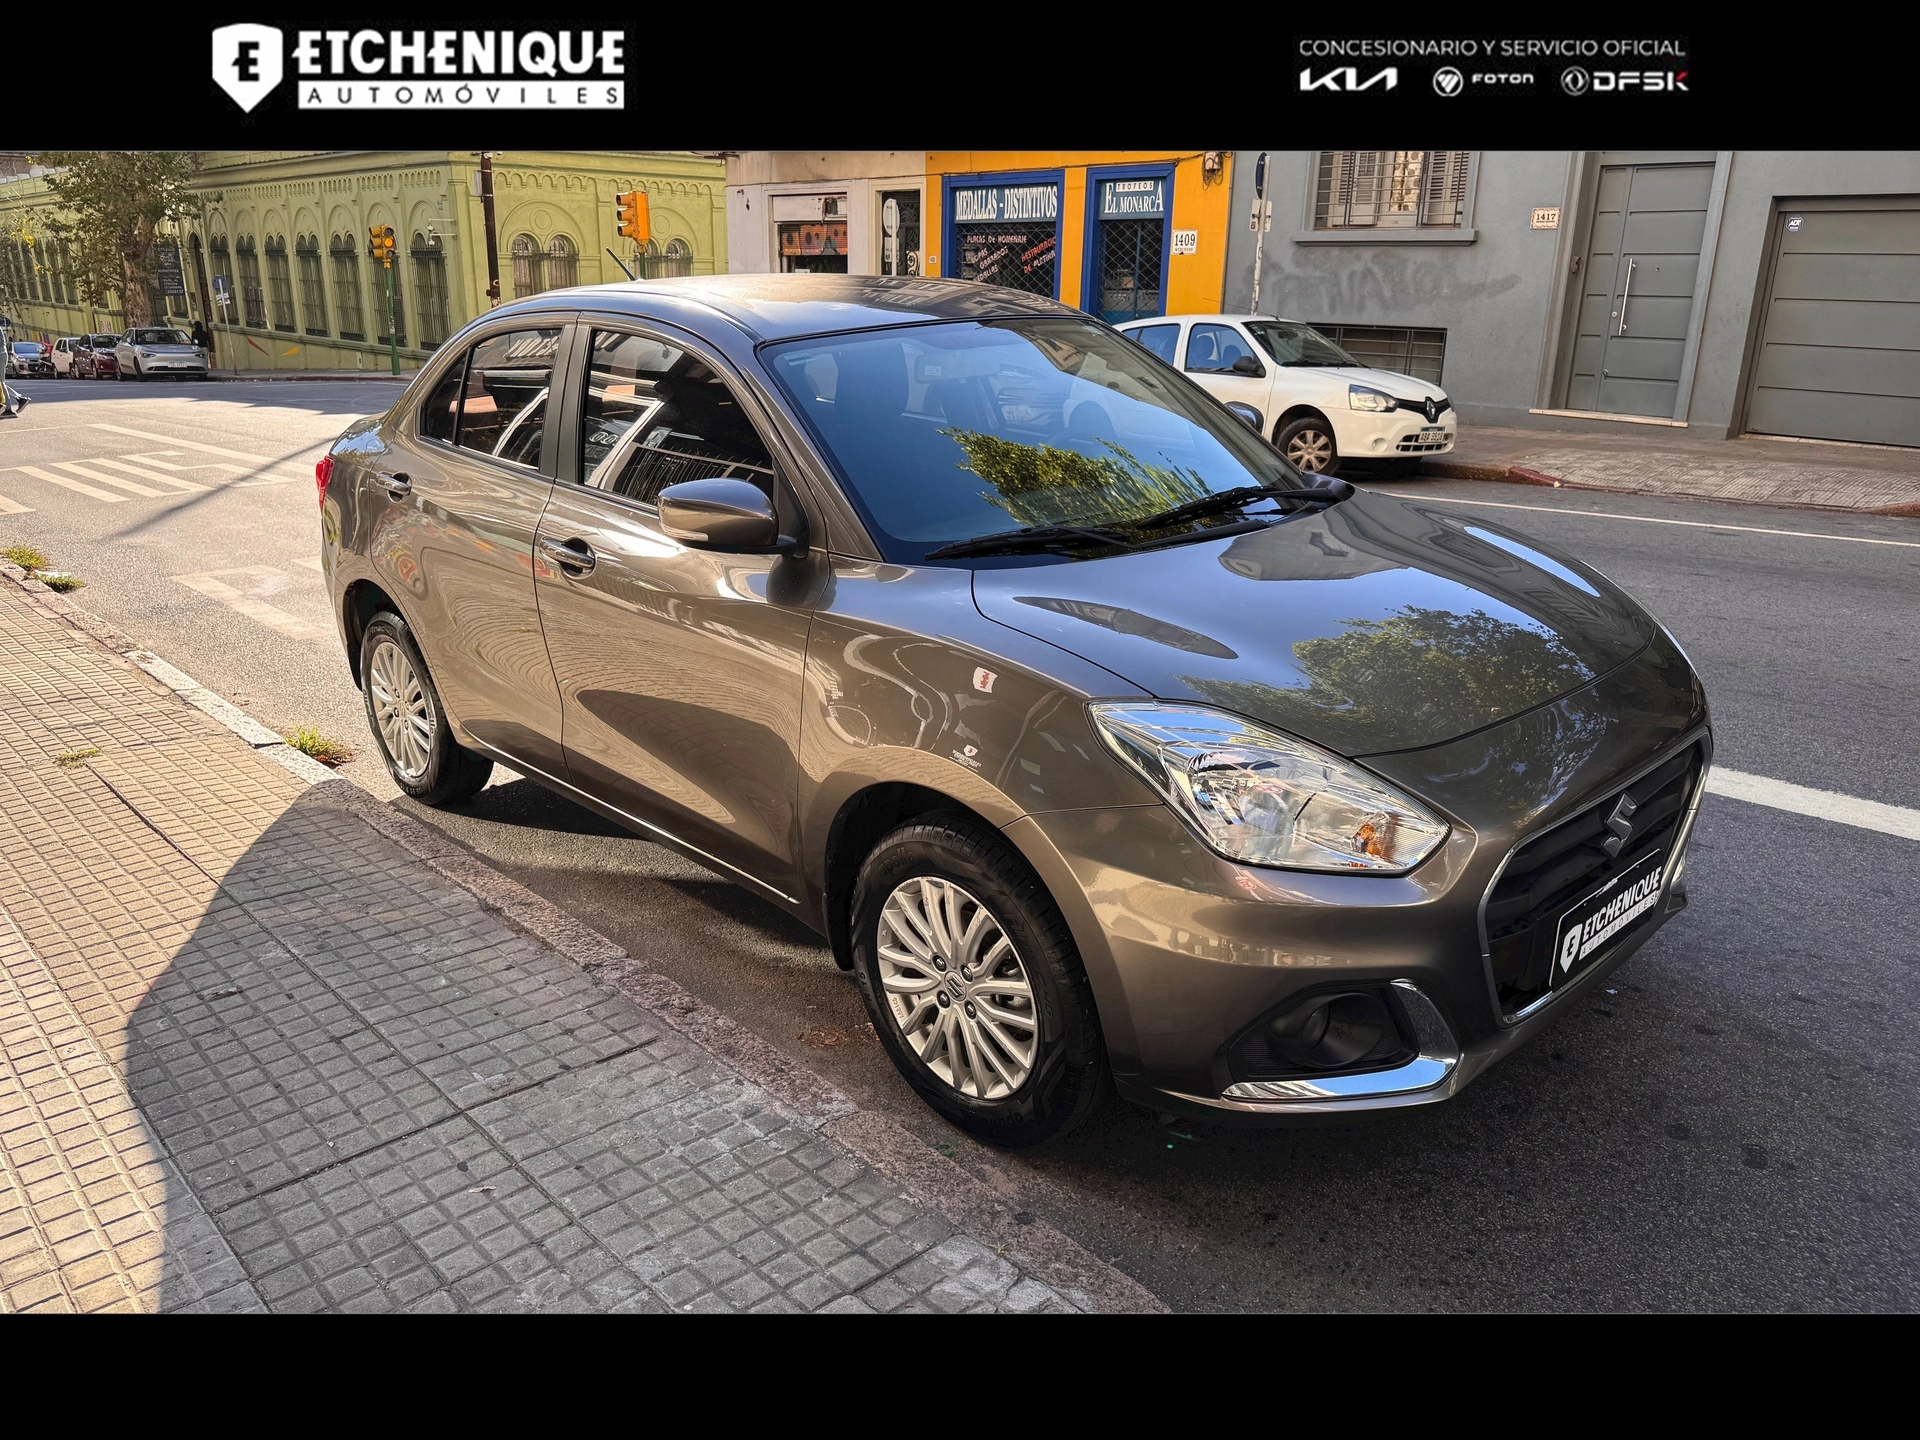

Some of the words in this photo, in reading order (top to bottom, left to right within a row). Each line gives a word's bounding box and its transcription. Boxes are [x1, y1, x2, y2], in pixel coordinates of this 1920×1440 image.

[1117, 182, 1153, 190] TROFEOS
[1119, 180, 1164, 213] MONARCA
[956, 188, 997, 221] MEDALLAS
[1004, 185, 1058, 219] DISTINTIVOS
[1536, 213, 1557, 221] 1417
[1174, 233, 1196, 247] 1409
[1582, 866, 1662, 943] ETCHENIQUE
